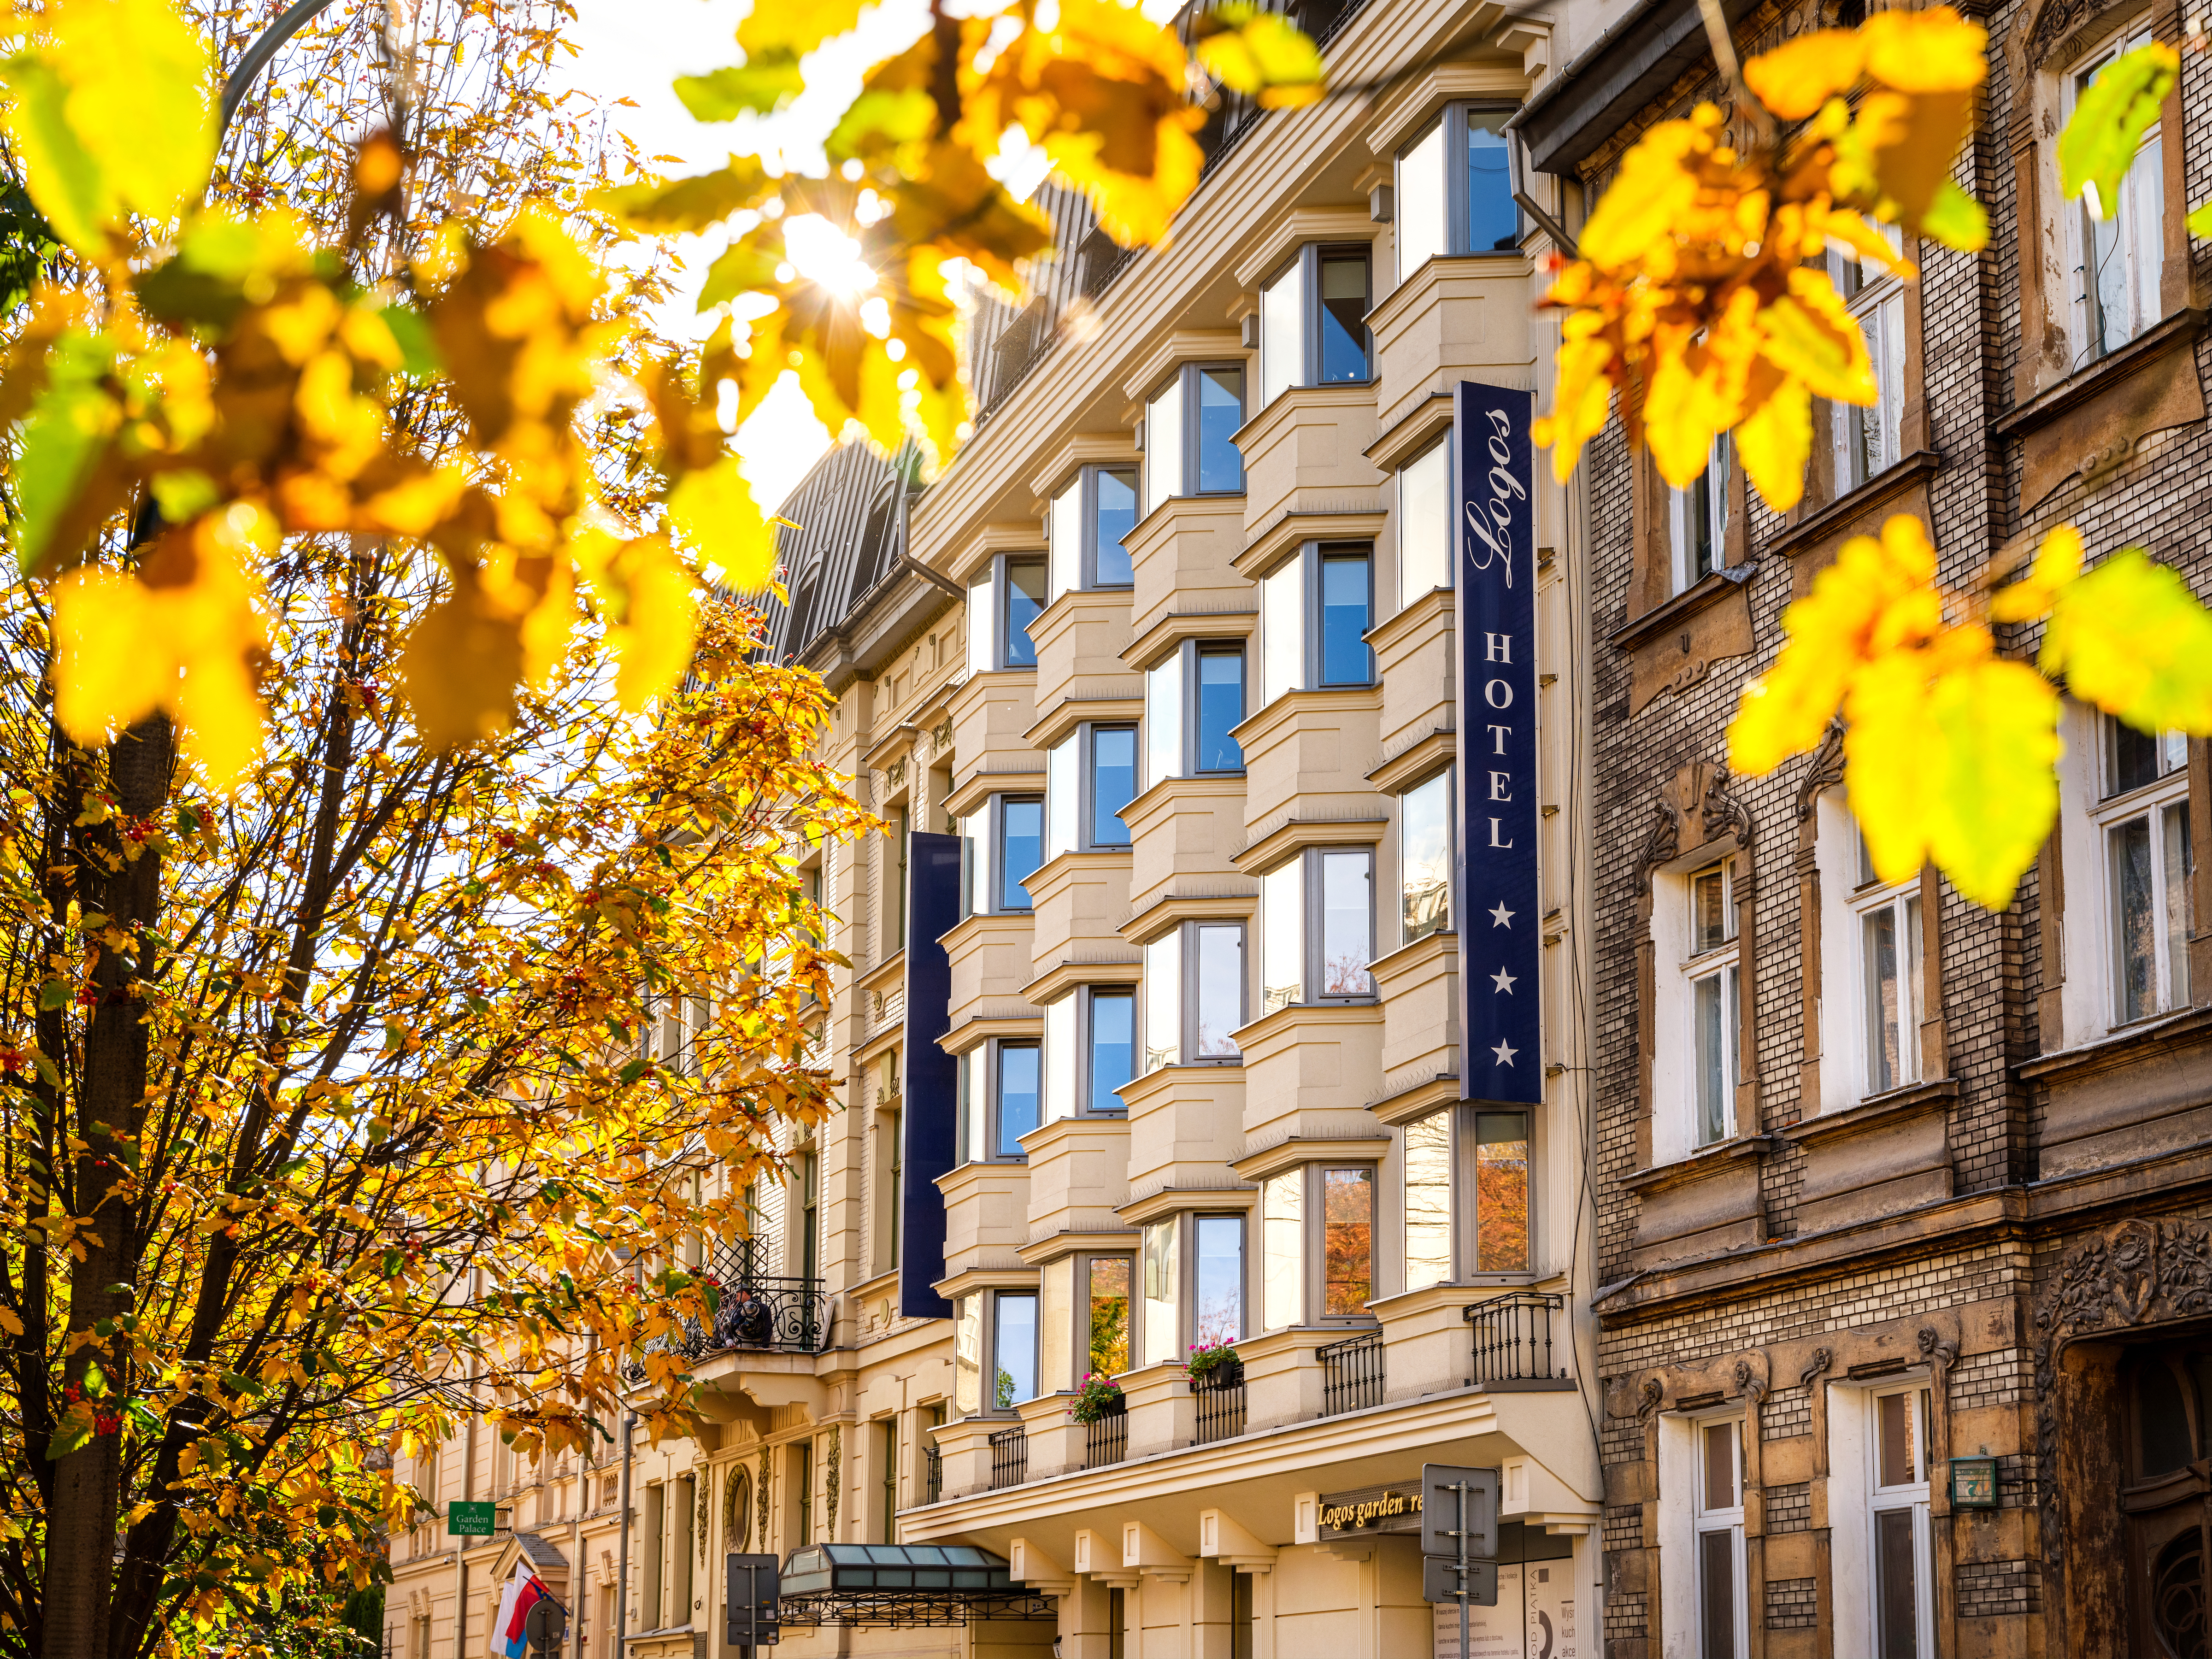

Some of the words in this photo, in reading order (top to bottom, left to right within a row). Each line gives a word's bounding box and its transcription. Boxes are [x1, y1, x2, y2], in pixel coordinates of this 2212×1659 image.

[1466, 409, 1526, 589] Logos
[1484, 632, 1514, 849] HOTEL
[1967, 1480, 1978, 1497] 7
[1317, 1503, 1354, 1530] Logos
[1356, 1491, 1403, 1528] garden
[1411, 1494, 1423, 1512] re
[456, 1515, 488, 1523] Garden
[459, 1524, 486, 1533] Palace
[1562, 1626, 1575, 1638] kuch
[1562, 1645, 1575, 1657] akce
